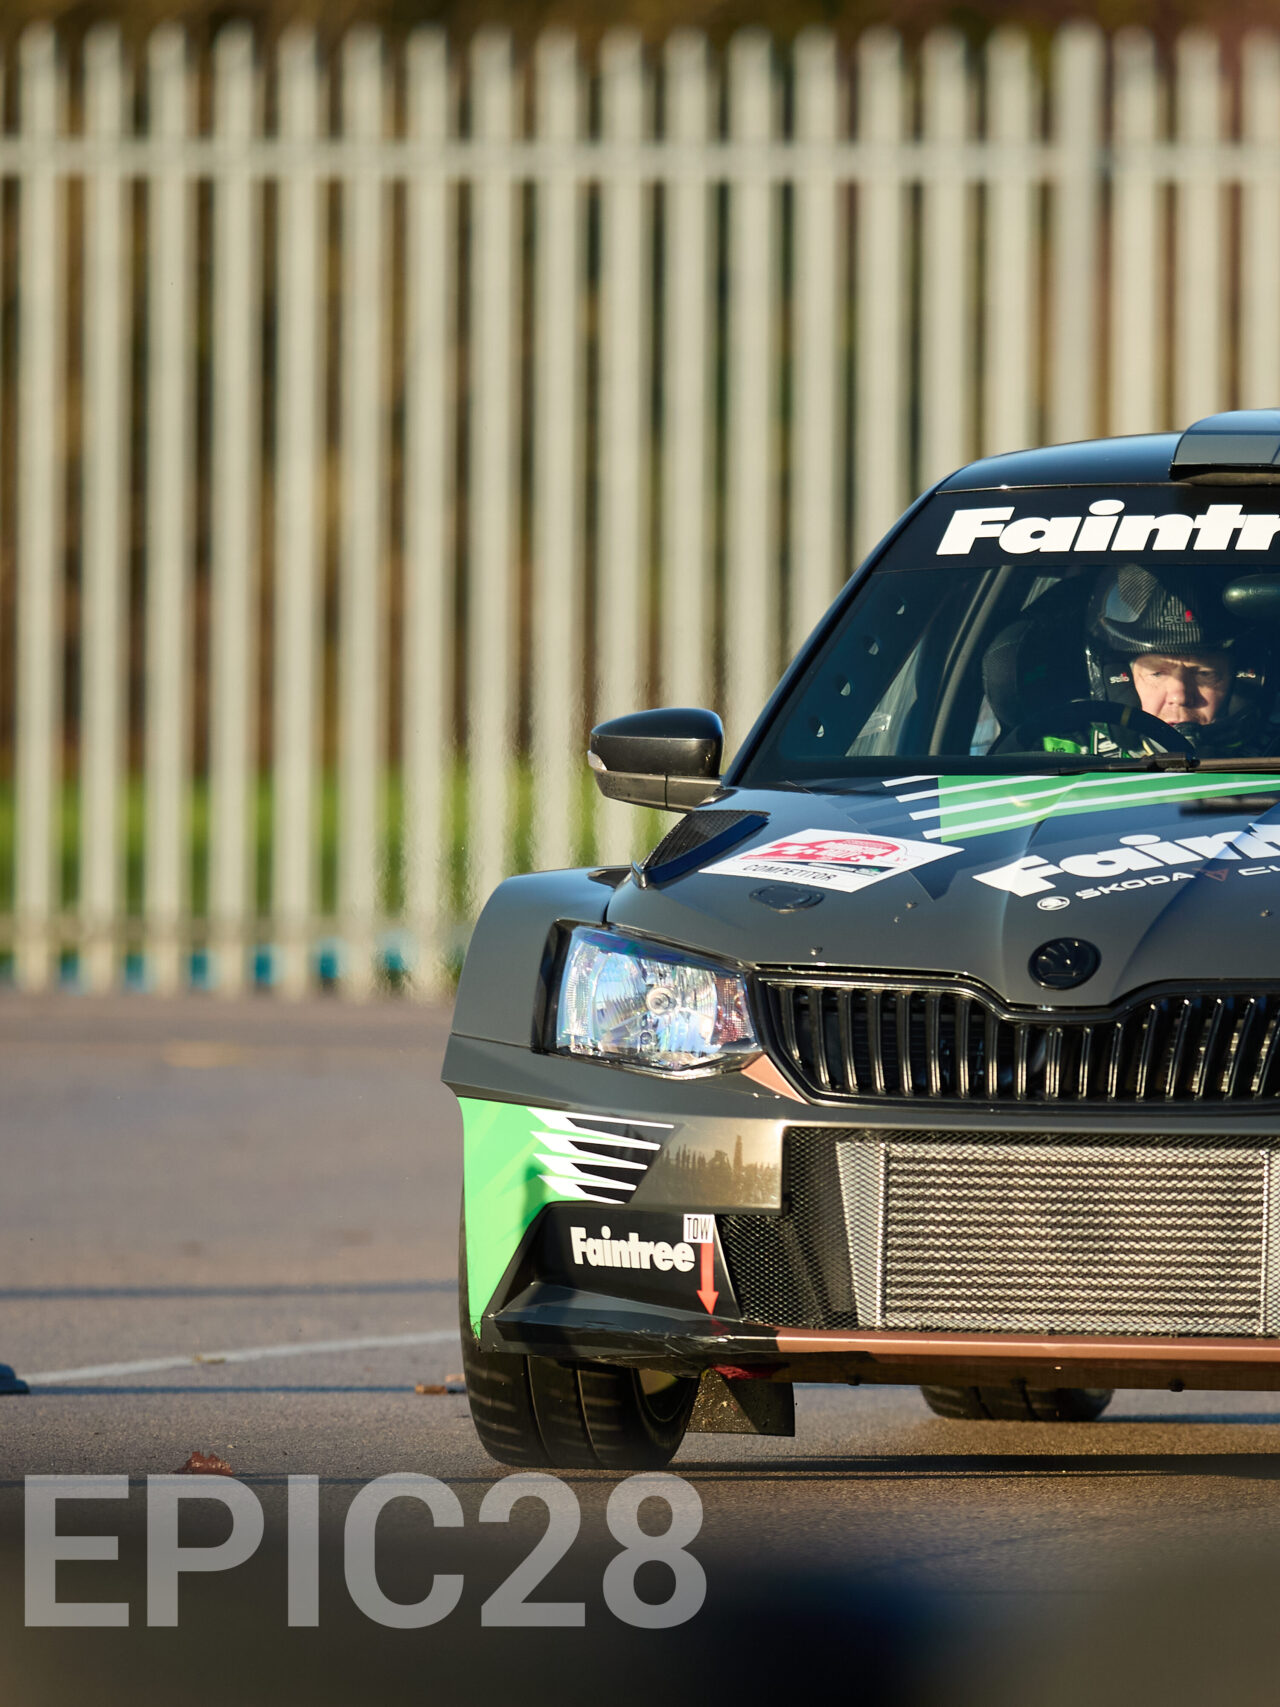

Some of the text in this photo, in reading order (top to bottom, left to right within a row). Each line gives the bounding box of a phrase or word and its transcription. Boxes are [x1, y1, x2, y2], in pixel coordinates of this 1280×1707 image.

[742, 863, 838, 882] COMPETITOR
[686, 1216, 711, 1241] TOW
[570, 1225, 696, 1273] Faintree
